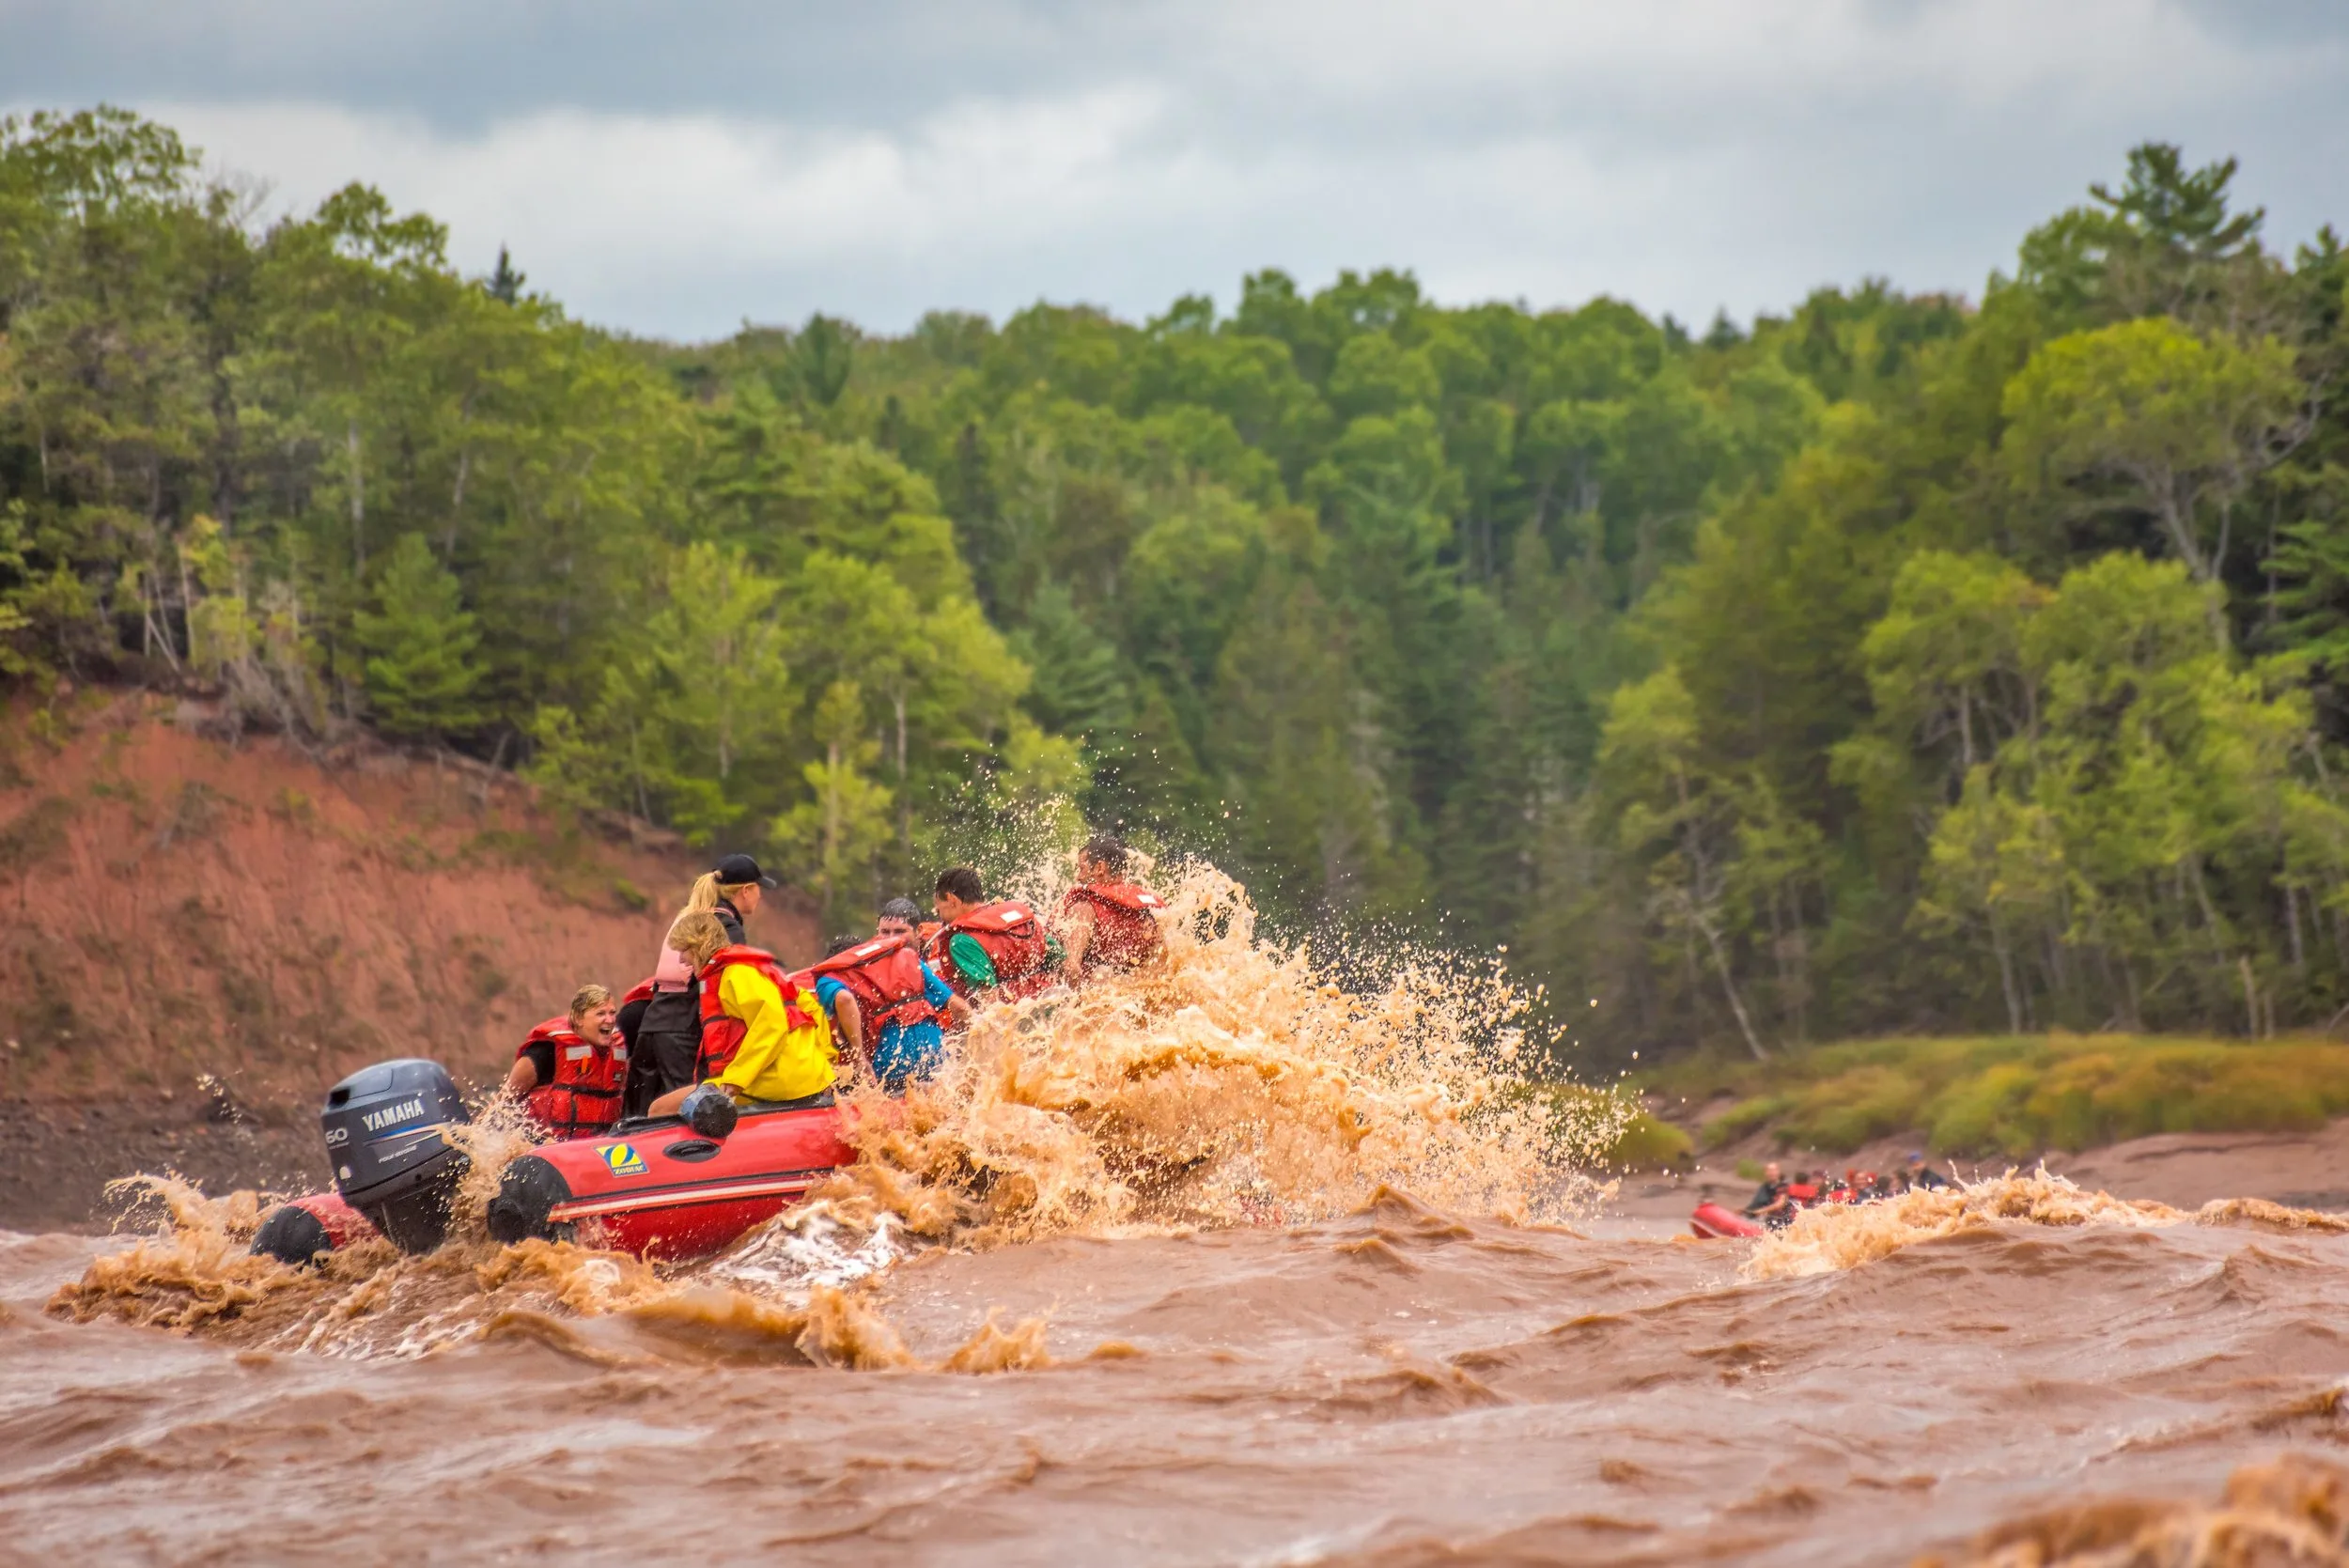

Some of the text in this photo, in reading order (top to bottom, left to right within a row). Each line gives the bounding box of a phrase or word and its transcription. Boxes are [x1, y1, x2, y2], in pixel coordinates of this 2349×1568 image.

[362, 1098, 425, 1132] YAMAHA
[325, 1127, 348, 1144] 60
[614, 1164, 645, 1175] ZODIAC
